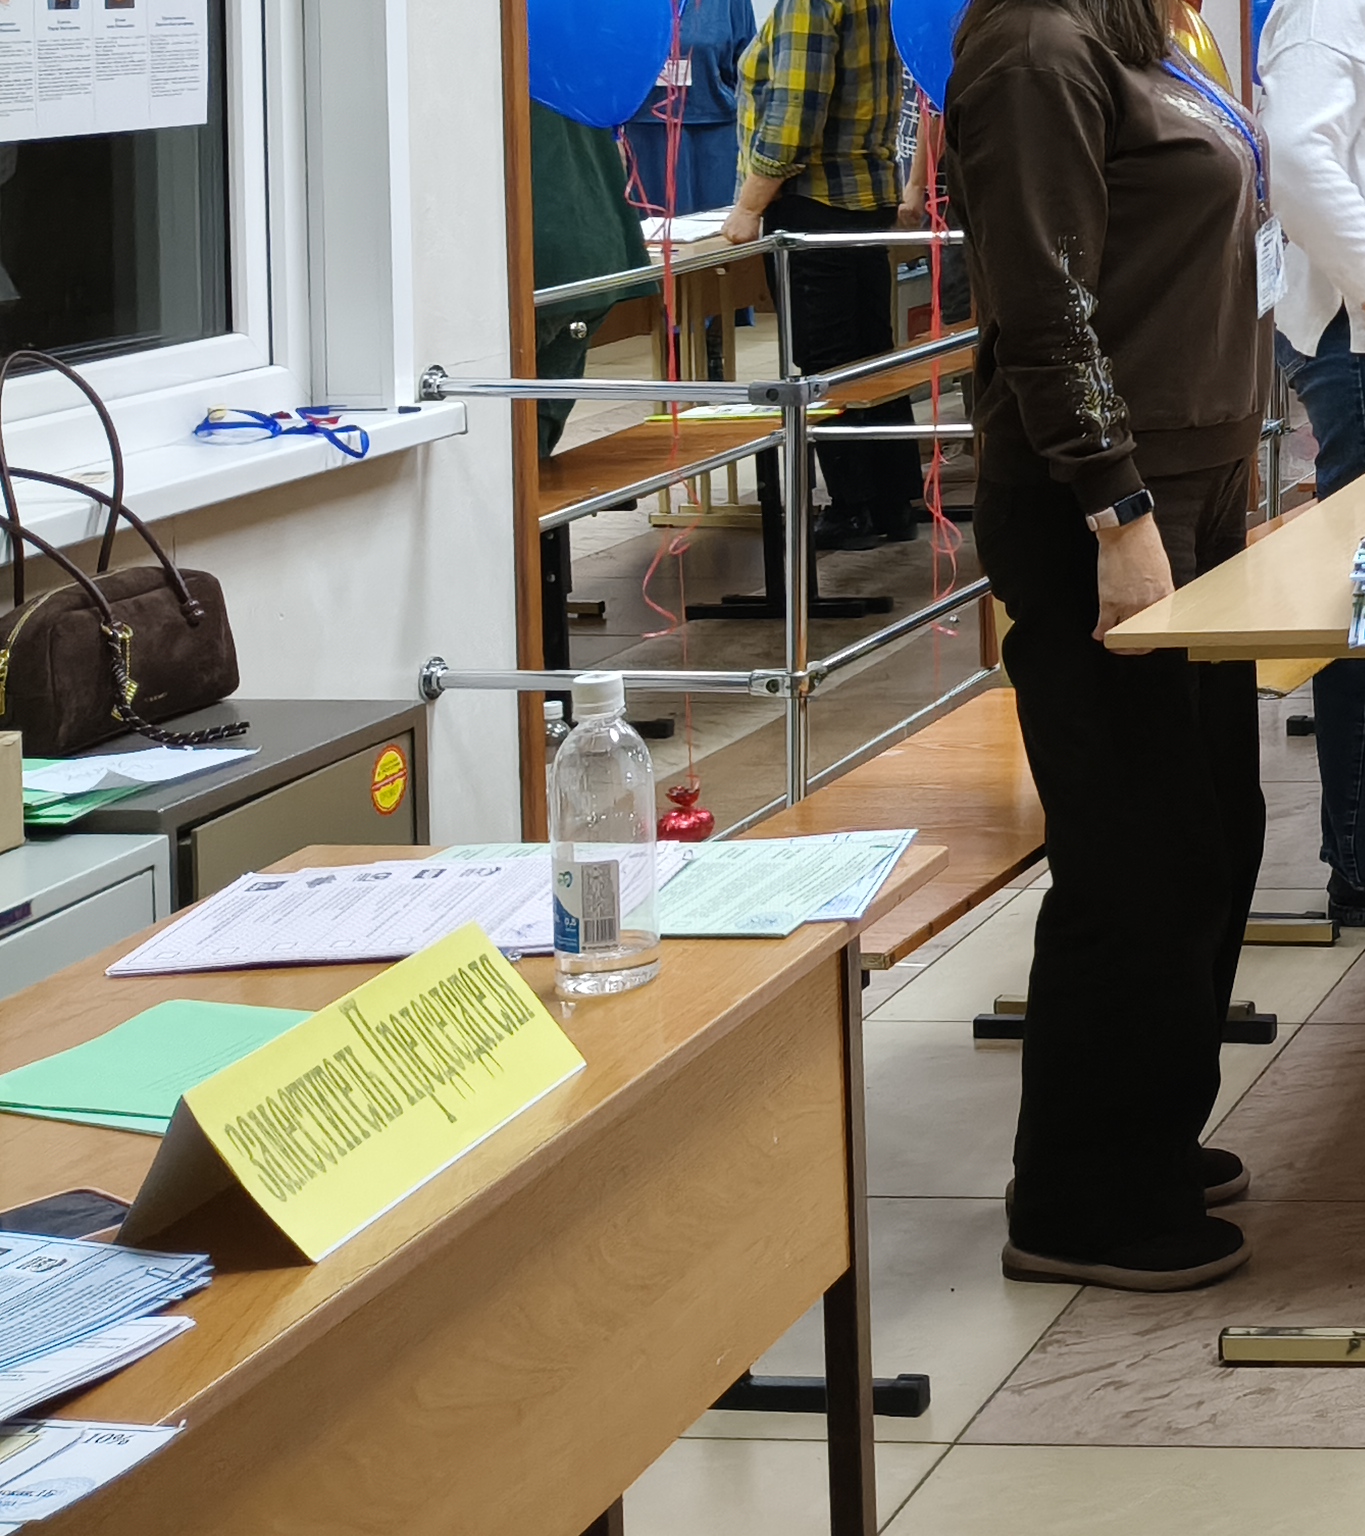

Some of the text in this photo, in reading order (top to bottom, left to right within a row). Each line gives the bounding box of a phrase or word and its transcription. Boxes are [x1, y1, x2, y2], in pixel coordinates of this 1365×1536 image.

[224, 953, 536, 1202] заместитель Председателя
[83, 1432, 135, 1446] 10%
